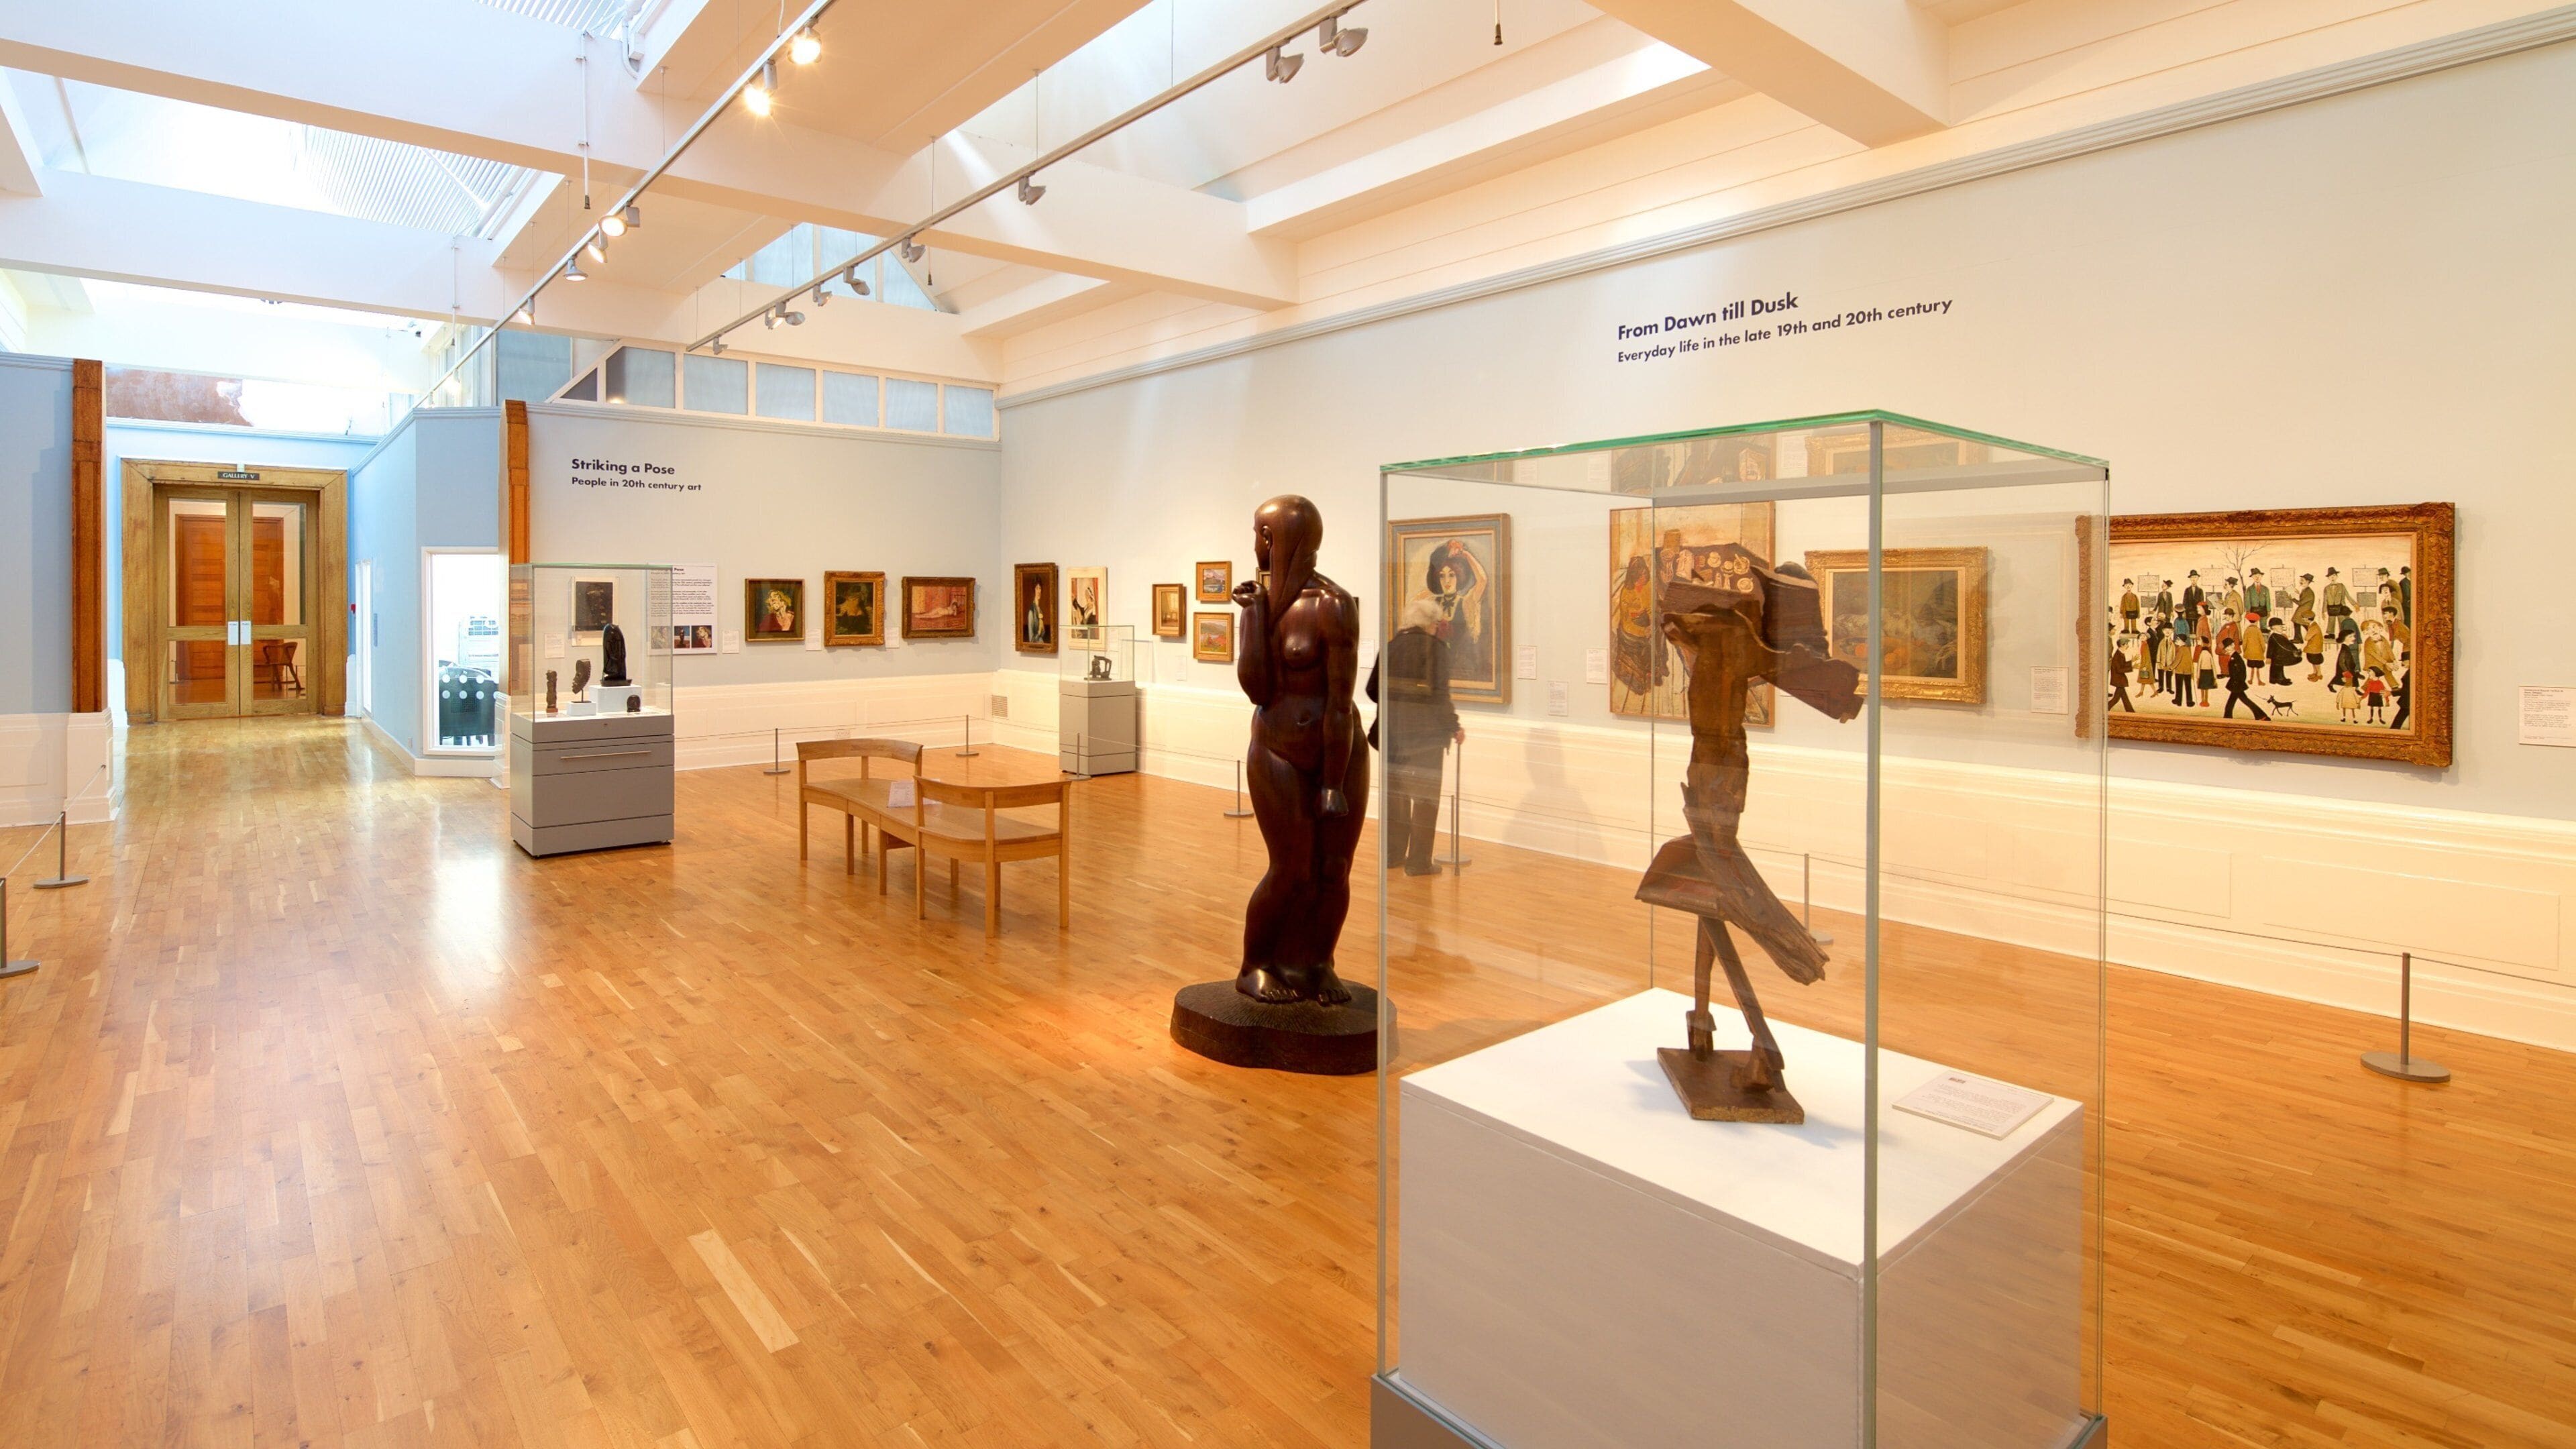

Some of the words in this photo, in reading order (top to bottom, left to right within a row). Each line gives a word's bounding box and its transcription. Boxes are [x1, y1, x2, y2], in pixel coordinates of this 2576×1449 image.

[1618, 323, 1659, 341] From
[1664, 312, 1717, 332] Dawn
[1722, 301, 1745, 321] till
[1751, 291, 1799, 316] Dusk
[1618, 345, 1676, 363] Everyday
[1679, 339, 1699, 353] life
[1703, 337, 1715, 350] in
[1719, 333, 1741, 347] the
[1744, 329, 1772, 343] late
[1777, 320, 1808, 337] 19th
[1812, 313, 1841, 332] and
[1845, 307, 1882, 327] 20th
[1887, 299, 1953, 320] century
[572, 458, 627, 475] Striking
[631, 465, 641, 473] a
[644, 463, 675, 475] Pose
[572, 476, 607, 488] People
[609, 478, 619, 487] in
[622, 479, 645, 488] 20th
[648, 482, 685, 492] century
